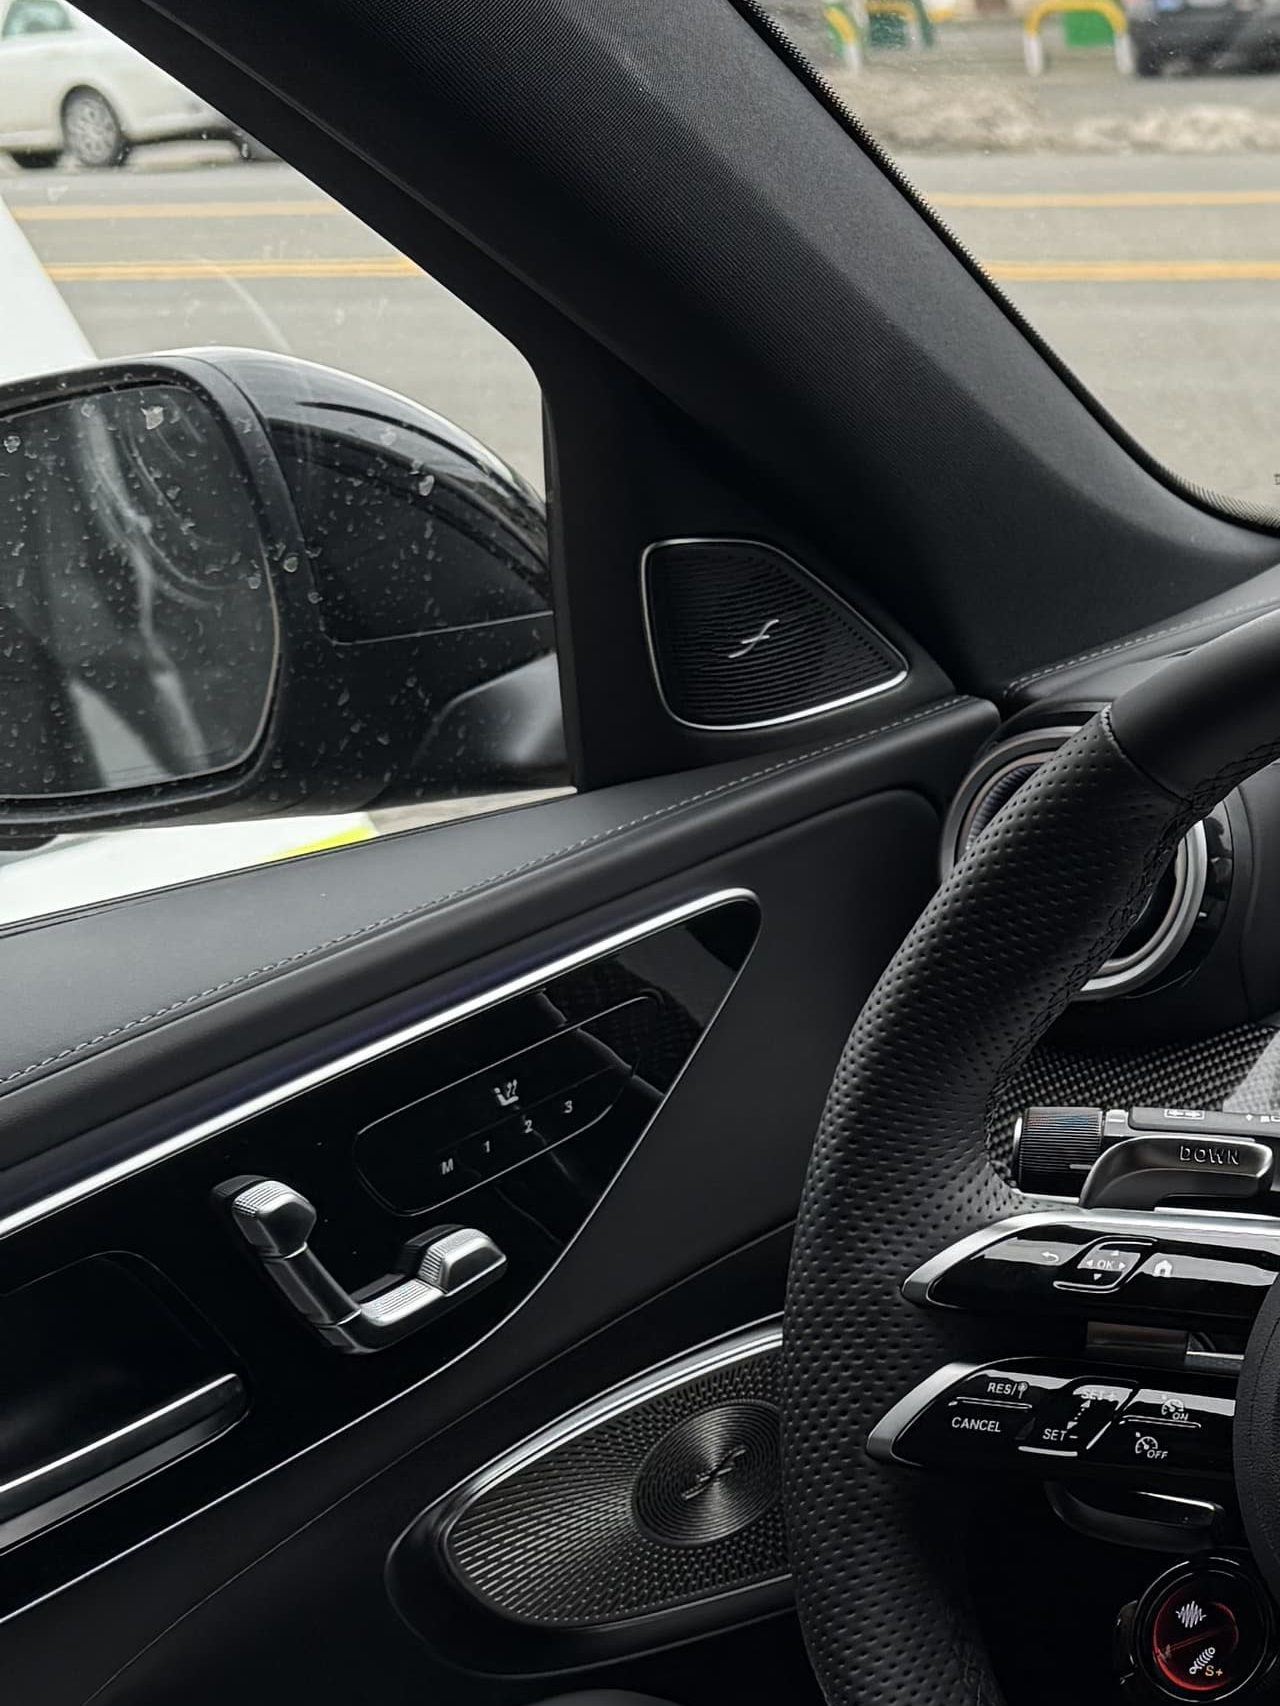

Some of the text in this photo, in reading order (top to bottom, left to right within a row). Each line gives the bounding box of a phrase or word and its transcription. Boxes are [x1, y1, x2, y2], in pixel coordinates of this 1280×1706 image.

[1179, 1145, 1240, 1166] DOWN
[441, 1158, 454, 1175] M
[1096, 1260, 1116, 1270] OK
[1171, 1412, 1189, 1421] ON
[951, 1416, 1002, 1433] CANCEL
[1042, 1428, 1068, 1442] SET
[1146, 1449, 1169, 1460] OFF
